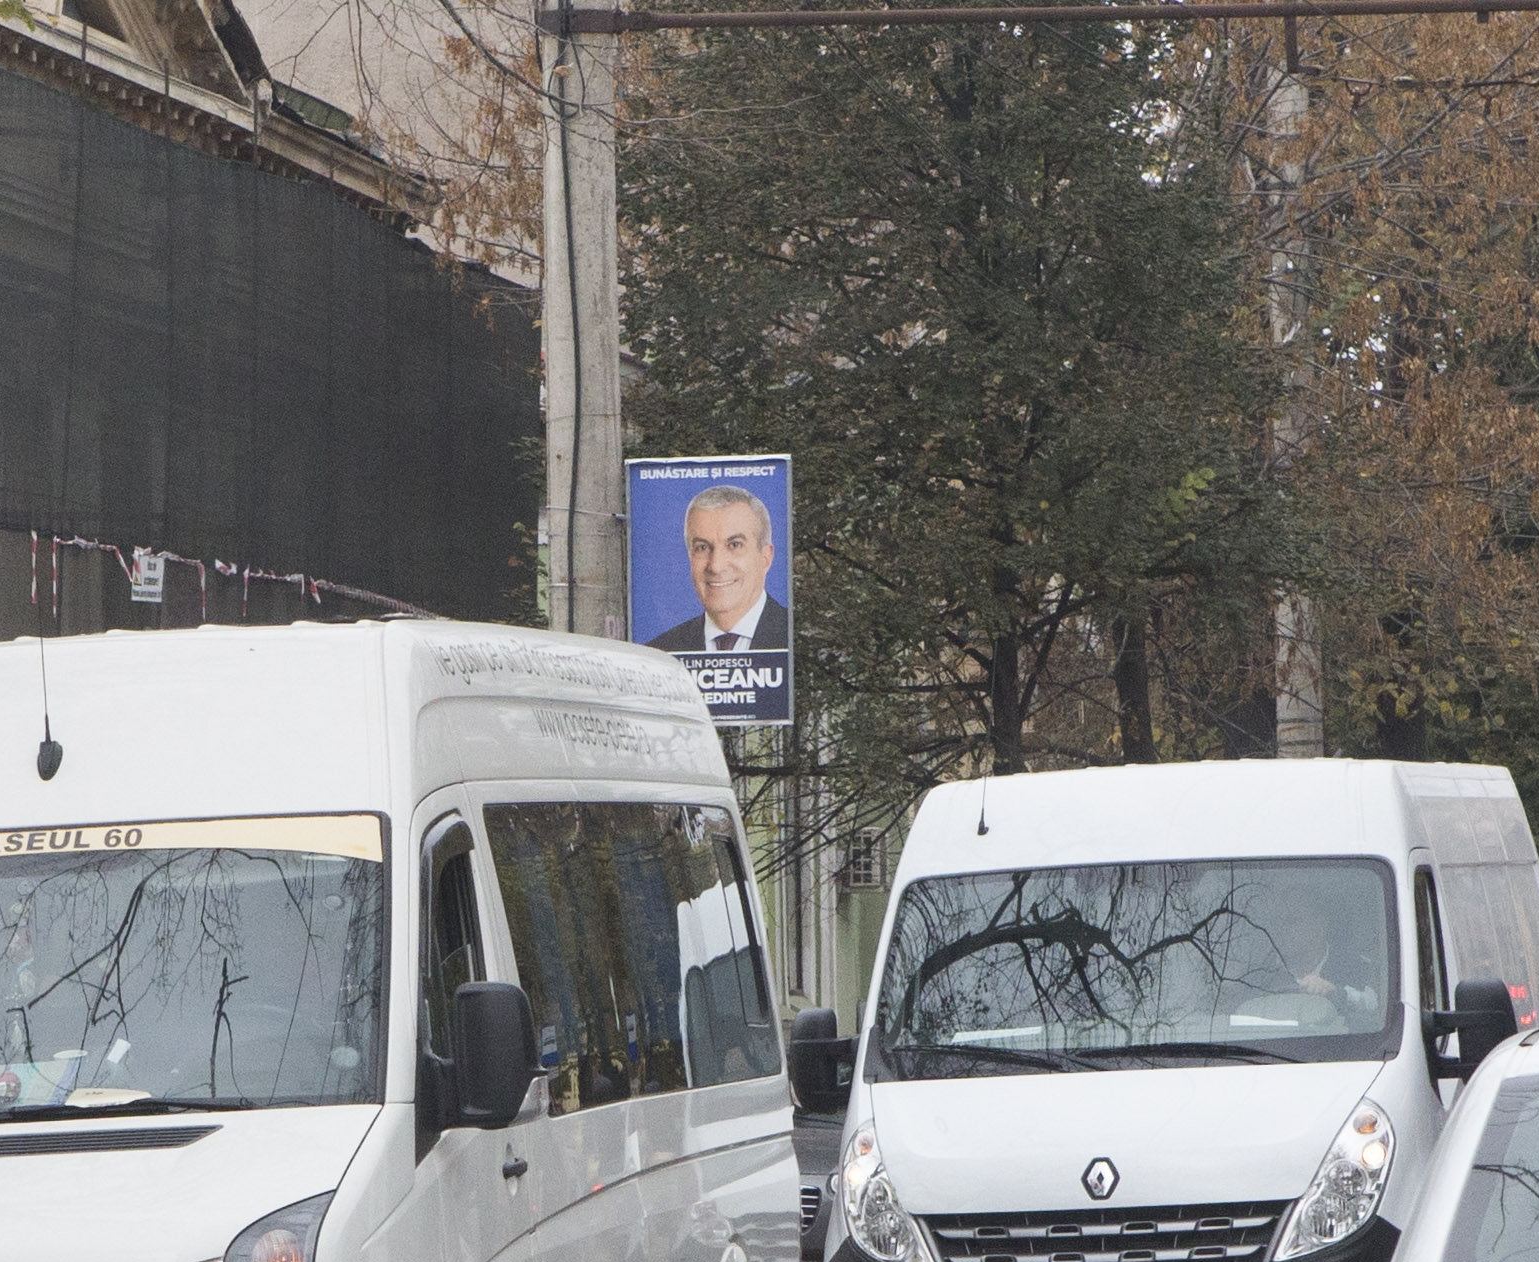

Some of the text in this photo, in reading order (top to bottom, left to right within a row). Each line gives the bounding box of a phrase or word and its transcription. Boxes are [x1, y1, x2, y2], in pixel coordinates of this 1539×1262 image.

[724, 465, 776, 477] RESPECT
[705, 657, 753, 668] POPESCU
[702, 691, 757, 705] EDINTE
[103, 828, 144, 848] 60
